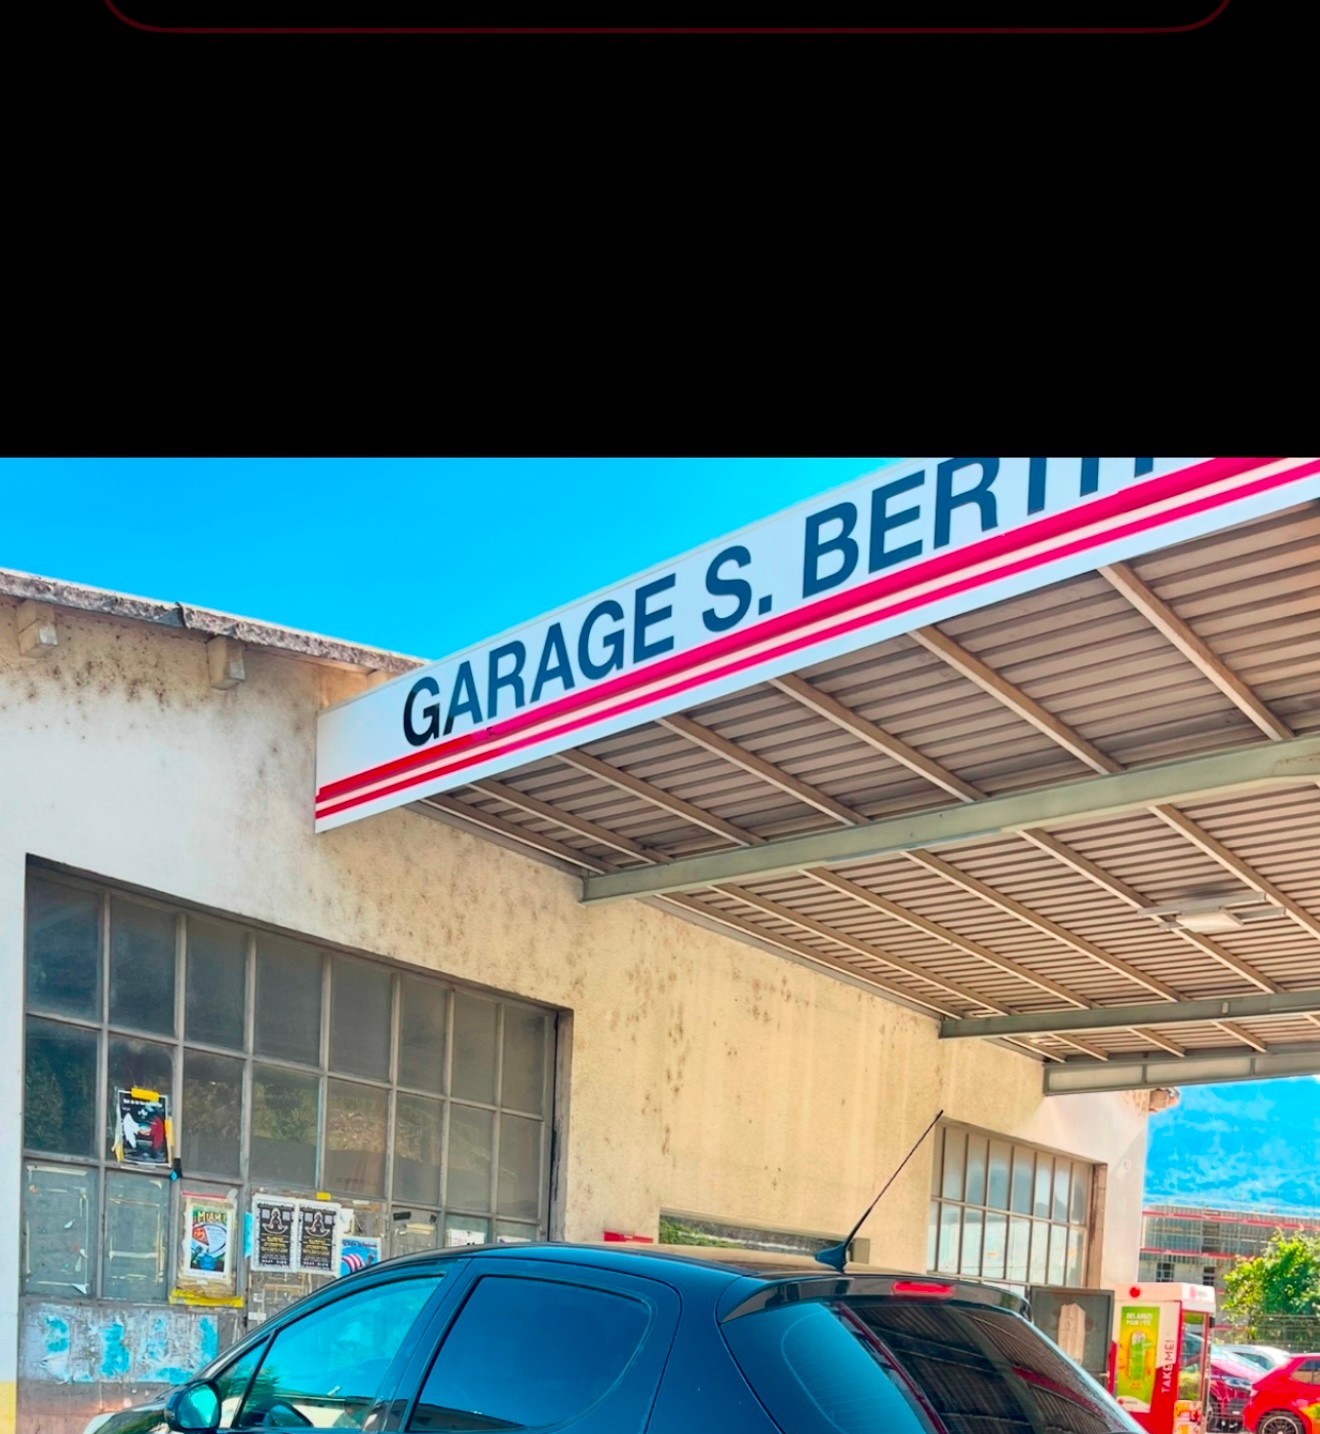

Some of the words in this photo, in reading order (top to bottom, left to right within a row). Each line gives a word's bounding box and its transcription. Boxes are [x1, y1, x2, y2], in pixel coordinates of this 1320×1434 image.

[403, 573, 676, 748] GARAGE
[702, 545, 772, 632] S.
[1161, 1363, 1173, 1393] TAKE
